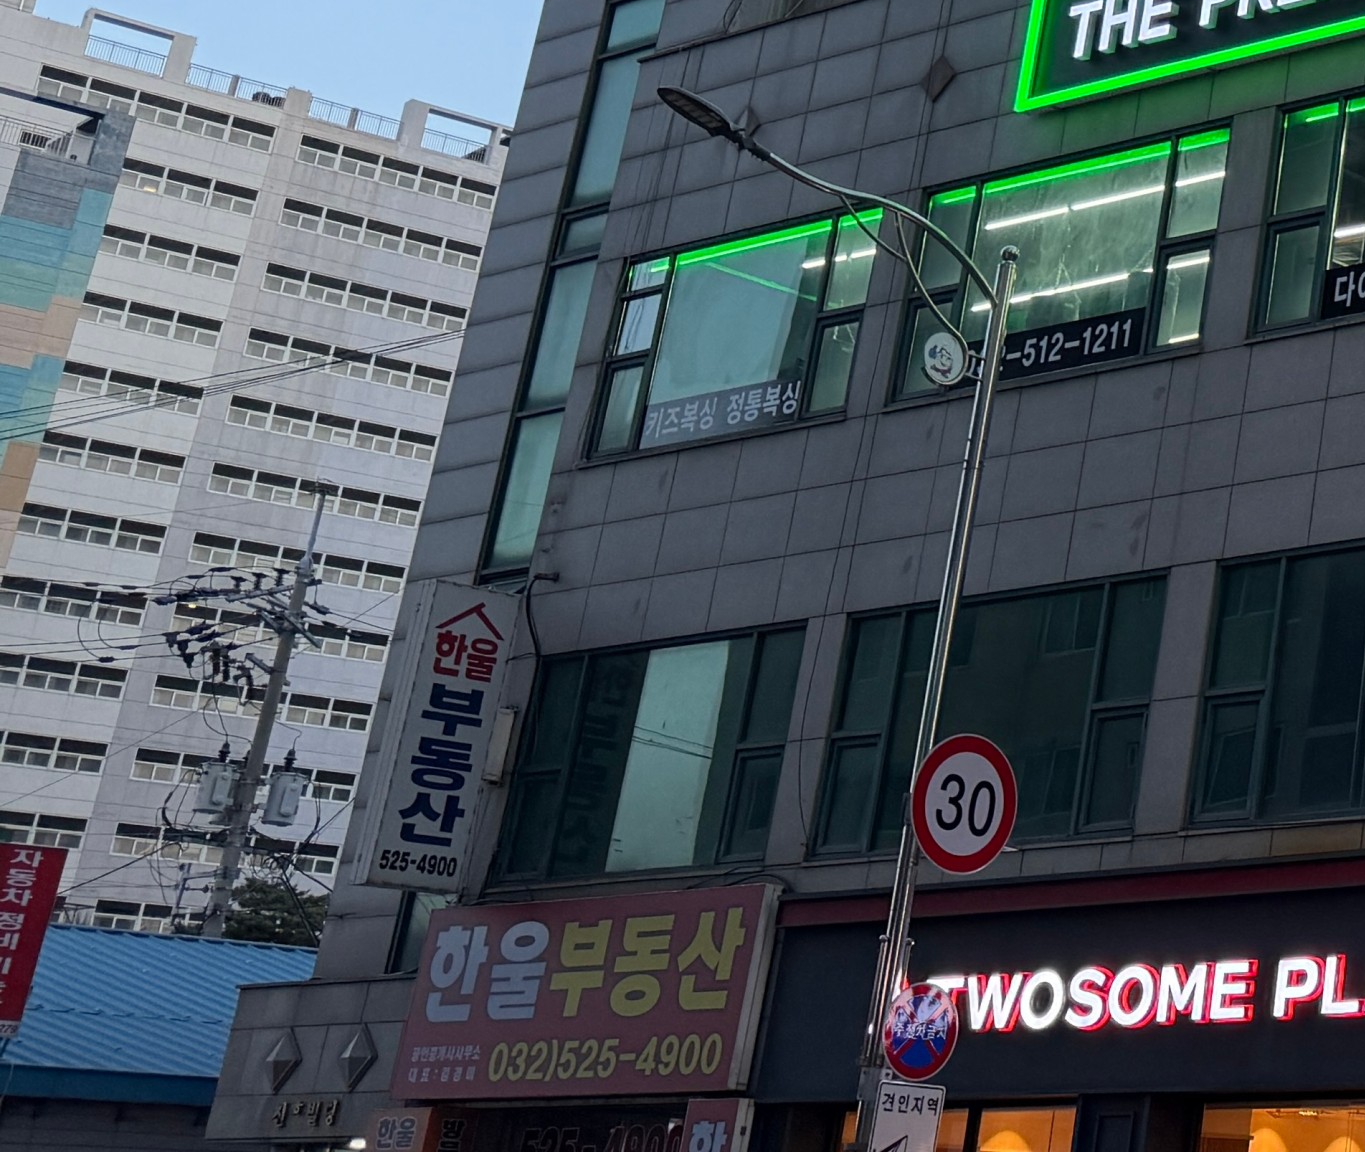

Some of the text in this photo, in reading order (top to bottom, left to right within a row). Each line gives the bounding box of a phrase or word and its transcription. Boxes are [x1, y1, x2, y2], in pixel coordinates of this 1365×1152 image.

[967, 318, 1133, 373] -512-1211
[645, 380, 801, 438] 키즈복싱 정통복싱
[433, 630, 499, 684] 한울
[398, 683, 485, 848] 부동산
[934, 773, 997, 837] 30
[1, 848, 44, 906] 자동차
[379, 850, 457, 877] 525-4900
[487, 1032, 723, 1084] 032)525-4900
[882, 1092, 940, 1116] 견인지역
[377, 1117, 416, 1149] 한울
